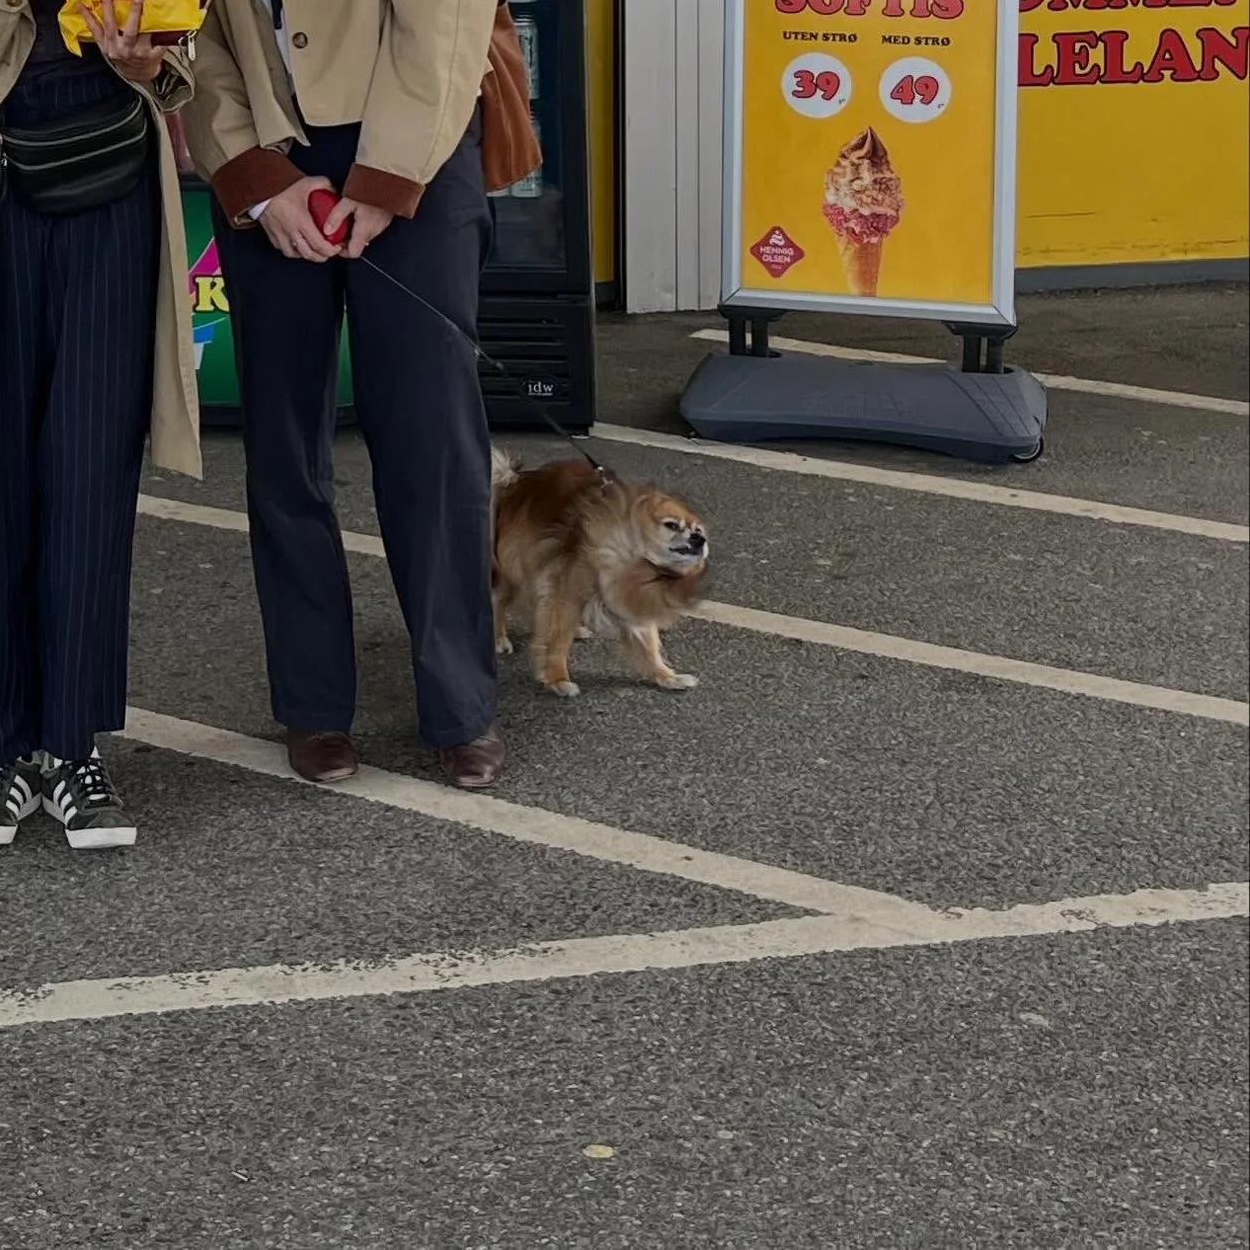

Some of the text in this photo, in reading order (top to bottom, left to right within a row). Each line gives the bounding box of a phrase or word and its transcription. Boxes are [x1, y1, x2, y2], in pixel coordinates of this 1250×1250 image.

[782, 31, 858, 43] UTEN STRØ
[881, 35, 950, 46] MED STRØ
[791, 70, 841, 100] 39
[890, 74, 939, 105] 49
[760, 246, 794, 256] HENNIG
[762, 254, 791, 263] OLSEN
